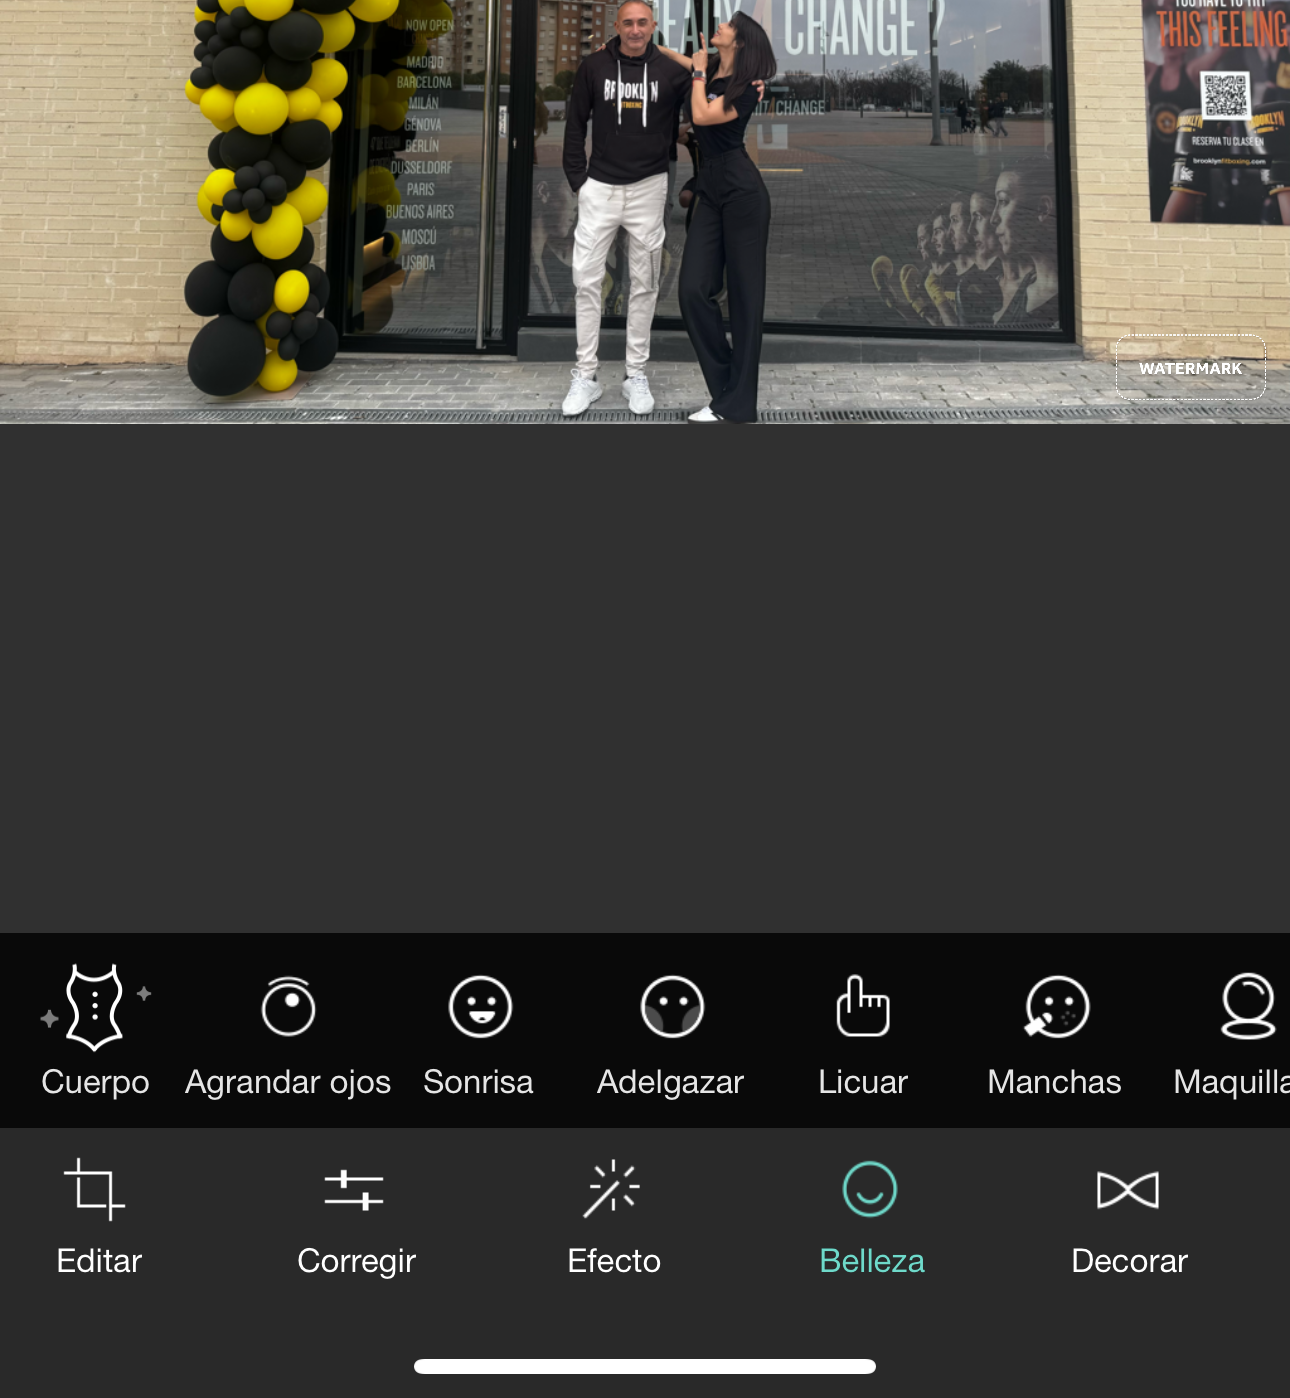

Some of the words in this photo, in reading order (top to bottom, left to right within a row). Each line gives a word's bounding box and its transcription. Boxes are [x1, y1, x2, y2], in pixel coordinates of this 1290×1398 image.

[406, 19, 428, 32] NOW
[429, 19, 454, 32] OPEN
[1156, 10, 1202, 47] THIS
[1207, 10, 1288, 47] FEELING
[406, 55, 443, 69] MADRID
[397, 76, 452, 89] BARCELONA
[604, 78, 658, 102] BROOKLN
[408, 94, 439, 110] MILÁN
[404, 115, 441, 131] GÉNOVA
[405, 136, 439, 152] BERLÍN
[1192, 136, 1222, 146] RESERVA
[1222, 137, 1231, 146] TU
[1232, 137, 1253, 146] CLASE
[1254, 137, 1264, 146] EN
[391, 161, 452, 174] DUSSELDORF
[407, 183, 434, 196] PARIS
[386, 205, 424, 219] BUENOS
[426, 205, 454, 219] AIRES
[402, 226, 436, 245] MOSCÚ
[402, 256, 435, 271] LISBOA
[42, 1069, 149, 1100] Cuerpo
[185, 1069, 321, 1100] Agrandar
[331, 1069, 390, 1099] ojos
[424, 1069, 533, 1093] Sonrisa
[597, 1069, 744, 1100] Adelgazar
[821, 1069, 908, 1093] Licuar
[990, 1069, 1121, 1093] Manchas
[58, 1248, 142, 1272] Editar
[298, 1248, 416, 1279] Corregir
[569, 1248, 660, 1272] Efecto
[822, 1248, 925, 1272] Belleza
[1073, 1248, 1188, 1272] Decorar
